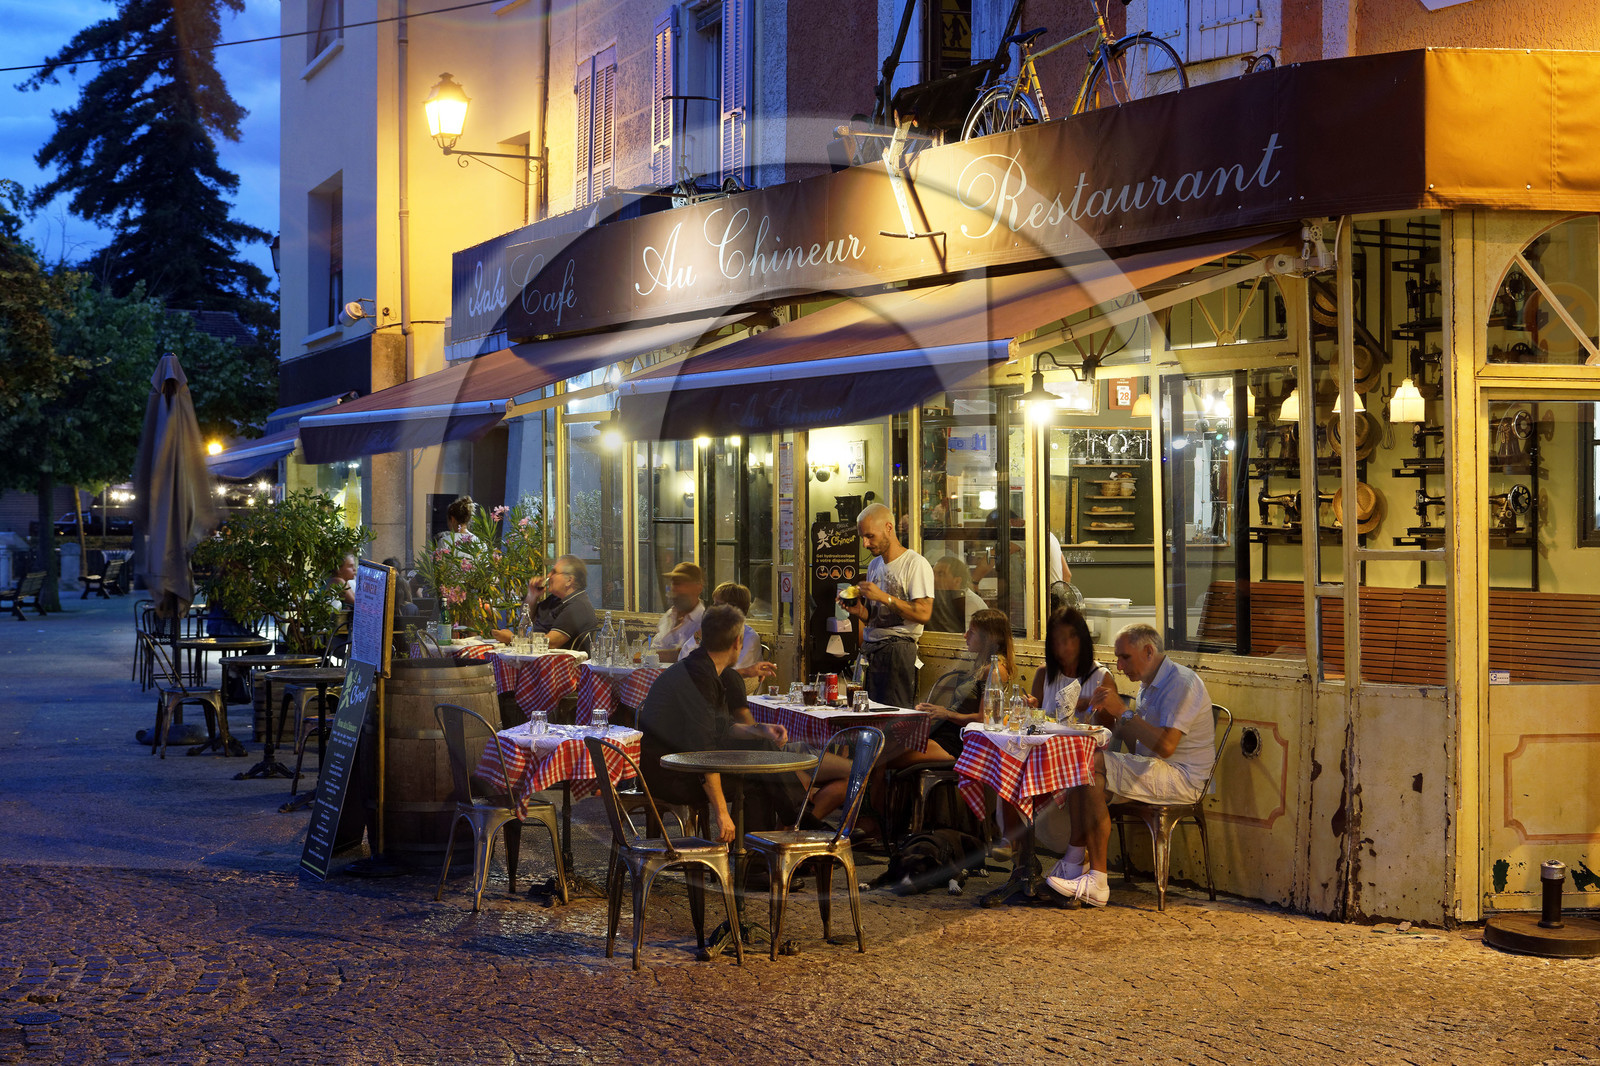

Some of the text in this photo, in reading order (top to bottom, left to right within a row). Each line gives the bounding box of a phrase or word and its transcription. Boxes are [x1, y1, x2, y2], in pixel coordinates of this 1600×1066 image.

[510, 132, 1283, 327] Café Au Chineur Restaurant
[1119, 391, 1130, 401] 28
